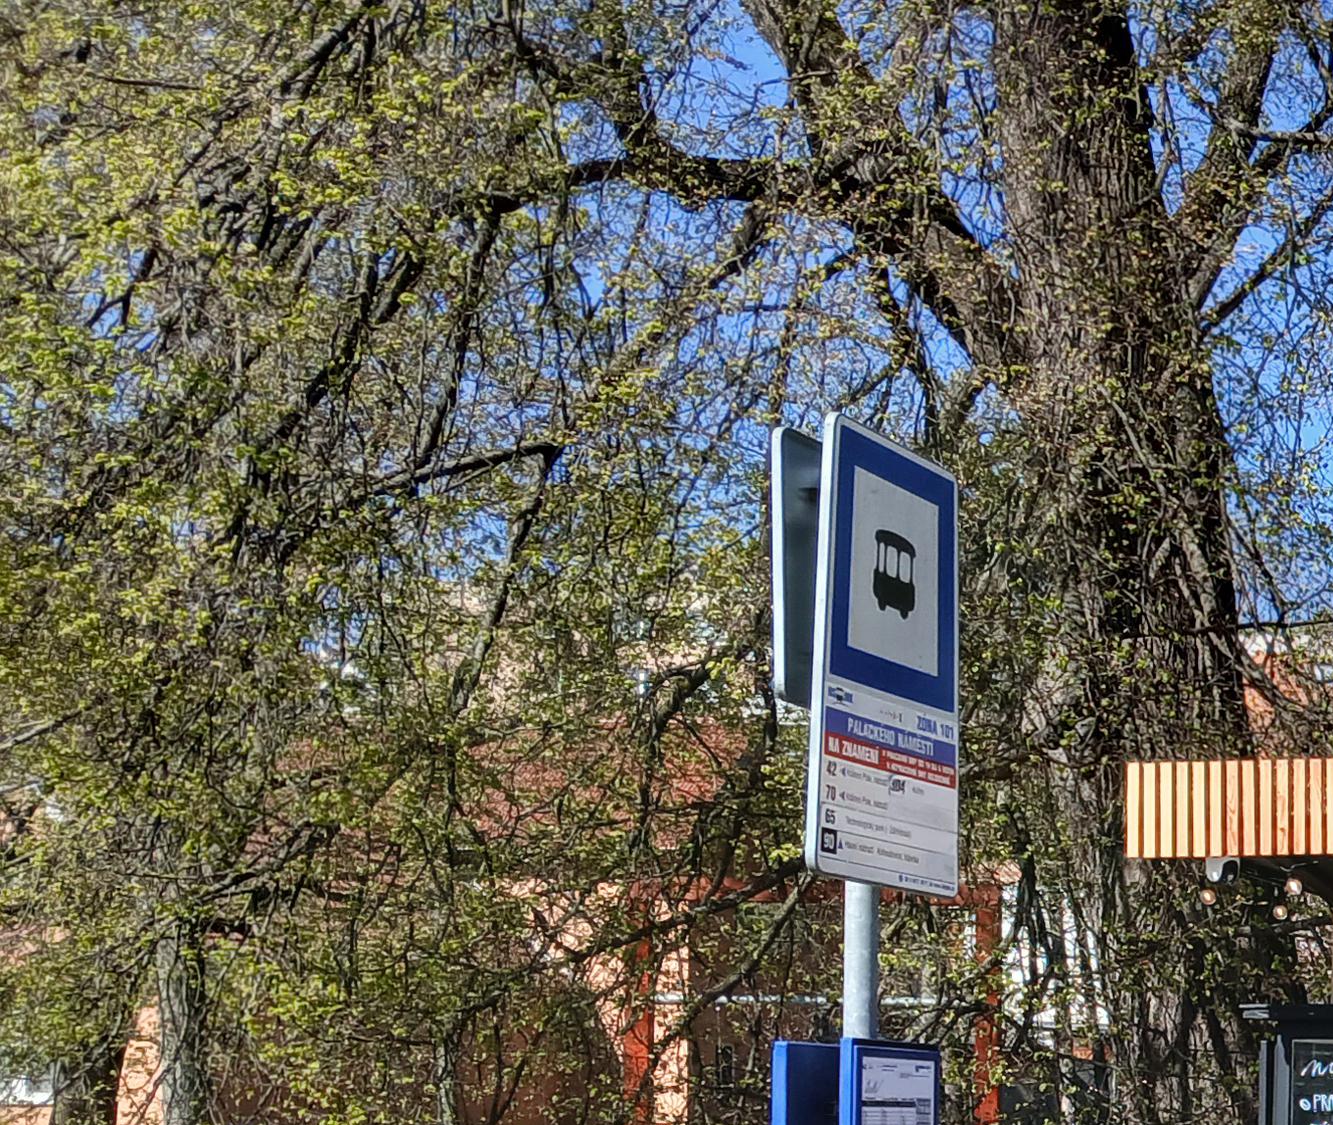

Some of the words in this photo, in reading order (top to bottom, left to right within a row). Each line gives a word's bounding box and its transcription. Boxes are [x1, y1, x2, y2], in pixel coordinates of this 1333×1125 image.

[847, 717, 895, 746] PALACKÉHO
[898, 730, 934, 756] NÁMĚSTÍ
[917, 712, 938, 736] ZÓNA
[940, 724, 954, 740] 101
[828, 736, 840, 754] NA
[842, 740, 880, 764] ZNAMENÍ
[826, 761, 837, 776] 42
[826, 784, 837, 801] 70
[825, 808, 836, 824] 65
